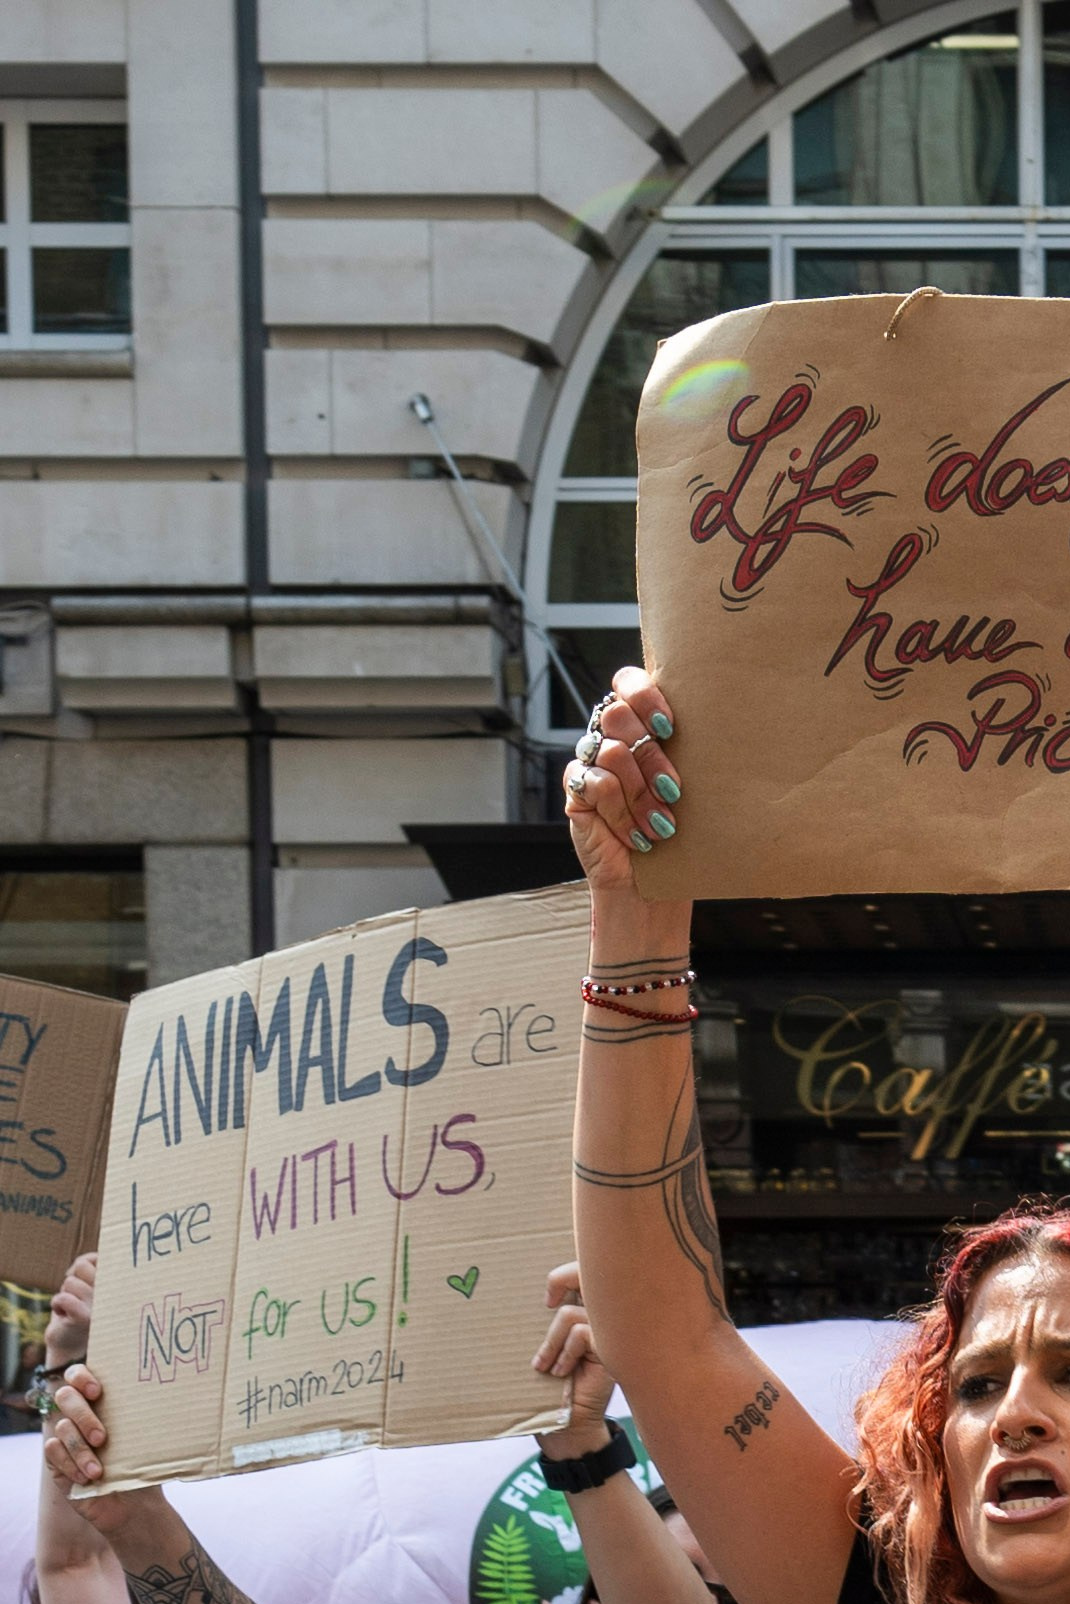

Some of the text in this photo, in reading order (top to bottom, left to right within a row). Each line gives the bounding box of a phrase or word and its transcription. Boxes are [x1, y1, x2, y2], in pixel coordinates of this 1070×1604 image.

[690, 383, 896, 594] Life
[824, 532, 1045, 684] have
[128, 936, 560, 1158] ANIMALS are
[131, 1181, 212, 1268] here
[249, 1139, 358, 1241] WITH
[138, 1292, 227, 1385] NOT
[241, 1287, 301, 1360] for
[236, 1349, 405, 1430] #narm2024
